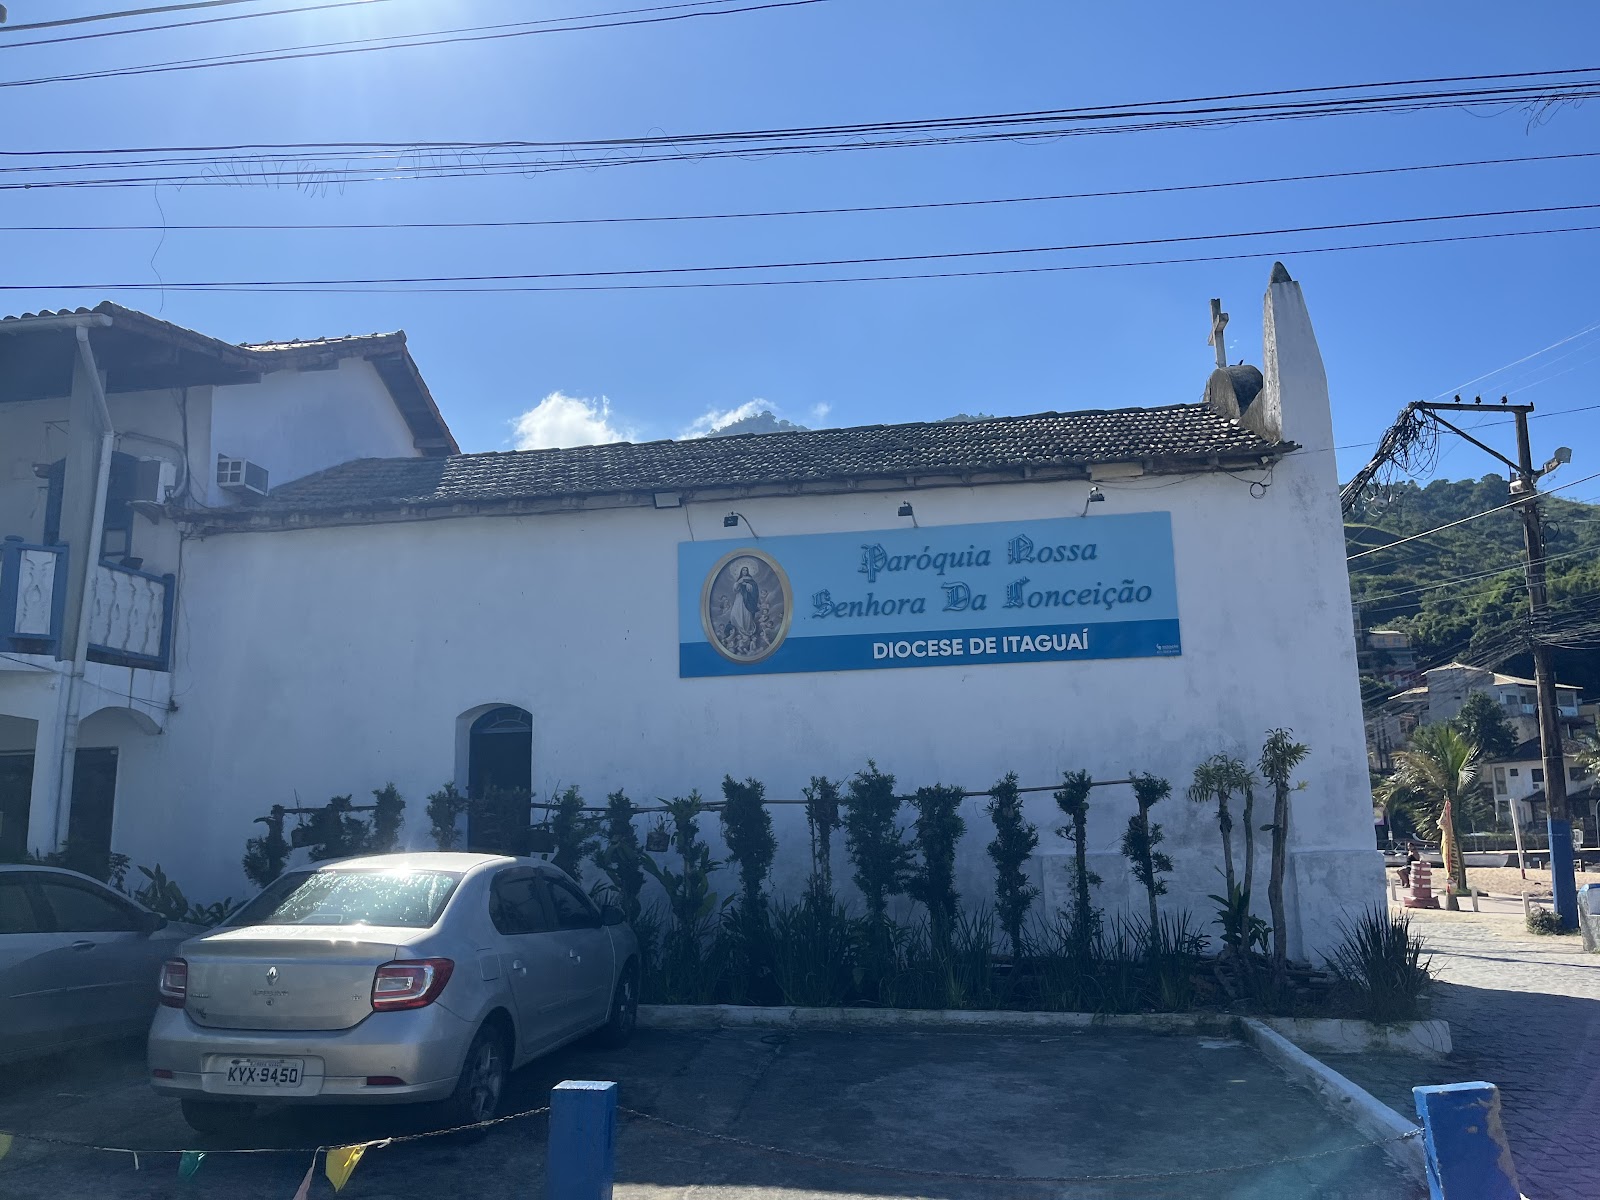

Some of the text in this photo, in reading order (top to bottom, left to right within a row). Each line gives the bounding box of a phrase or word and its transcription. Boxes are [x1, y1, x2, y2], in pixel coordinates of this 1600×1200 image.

[857, 533, 1098, 583] Paróquia Nossa
[811, 576, 1153, 619] Senhora Da Conceição
[873, 628, 1089, 659] DIOCESE DE ITAGUAÍ
